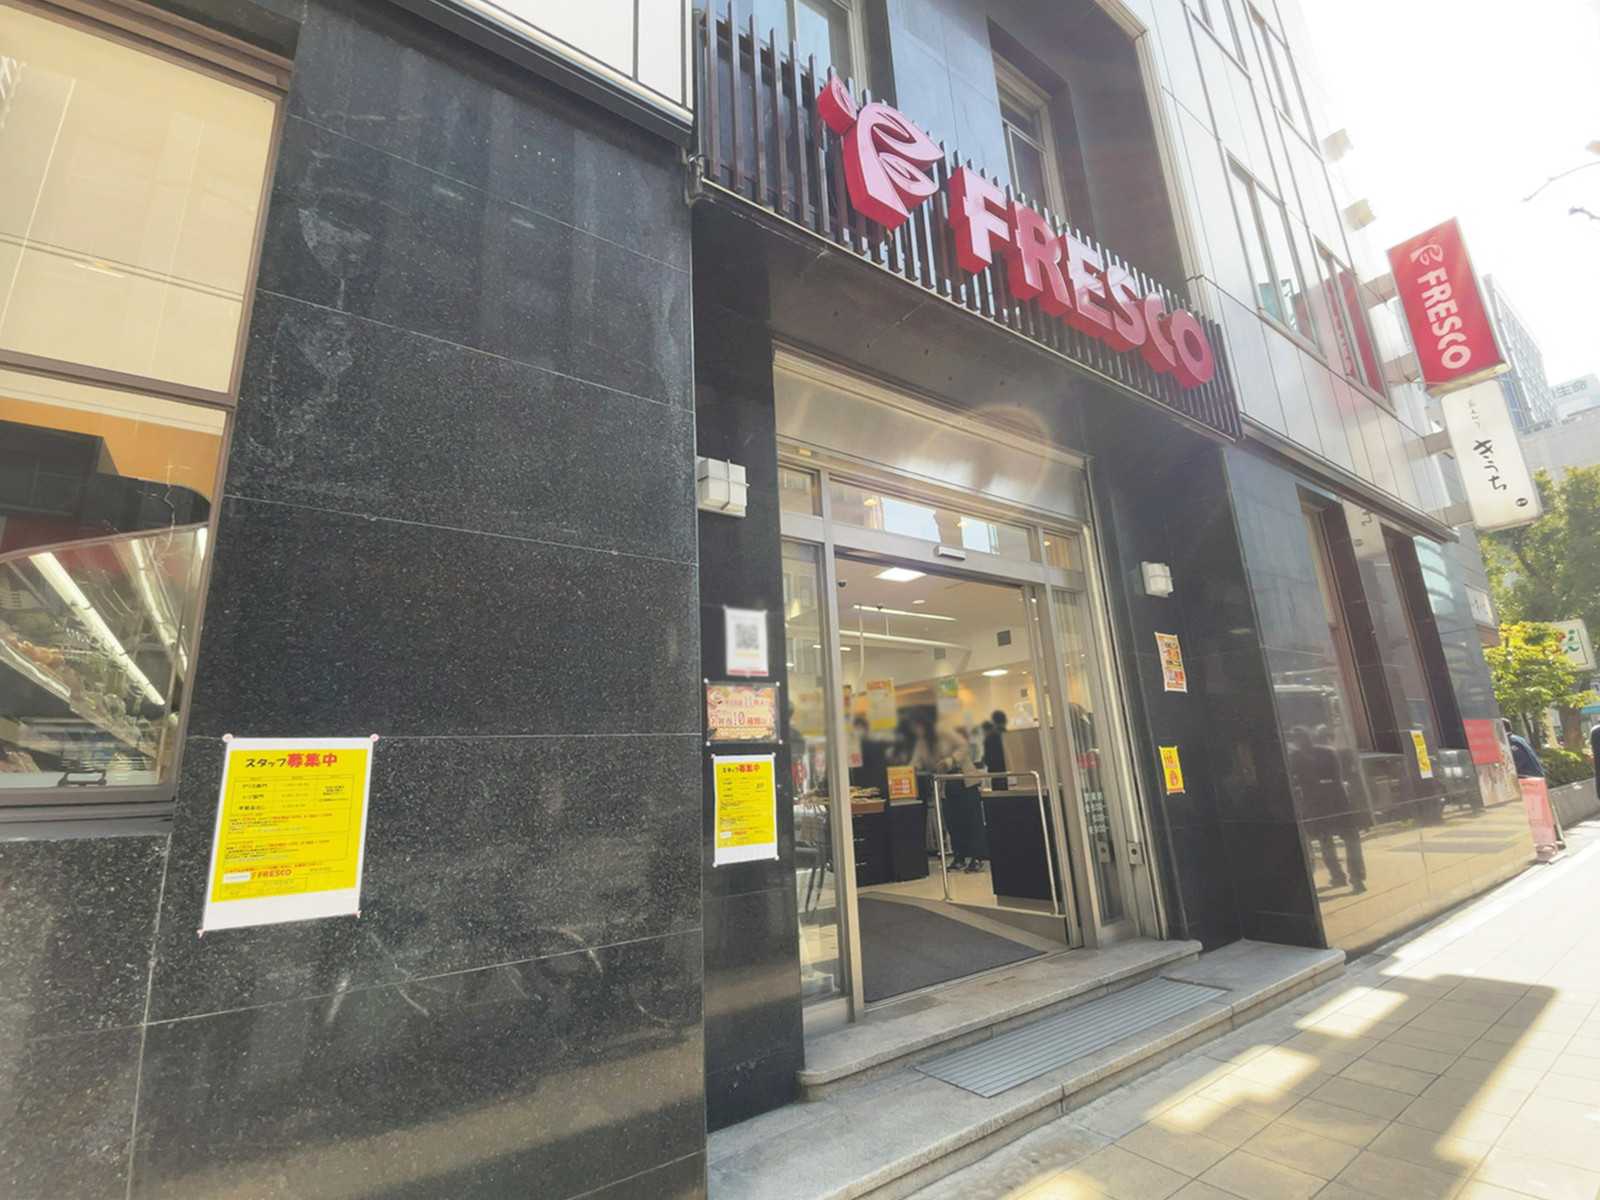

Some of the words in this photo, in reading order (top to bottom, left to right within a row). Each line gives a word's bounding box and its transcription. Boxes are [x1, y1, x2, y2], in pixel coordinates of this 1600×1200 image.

[948, 166, 1214, 388] FRESCO
[1417, 267, 1472, 370] FRESCO
[1551, 379, 1588, 399] 生命
[245, 753, 338, 768] スタッフ募集中
[257, 869, 292, 879] FRESCO
